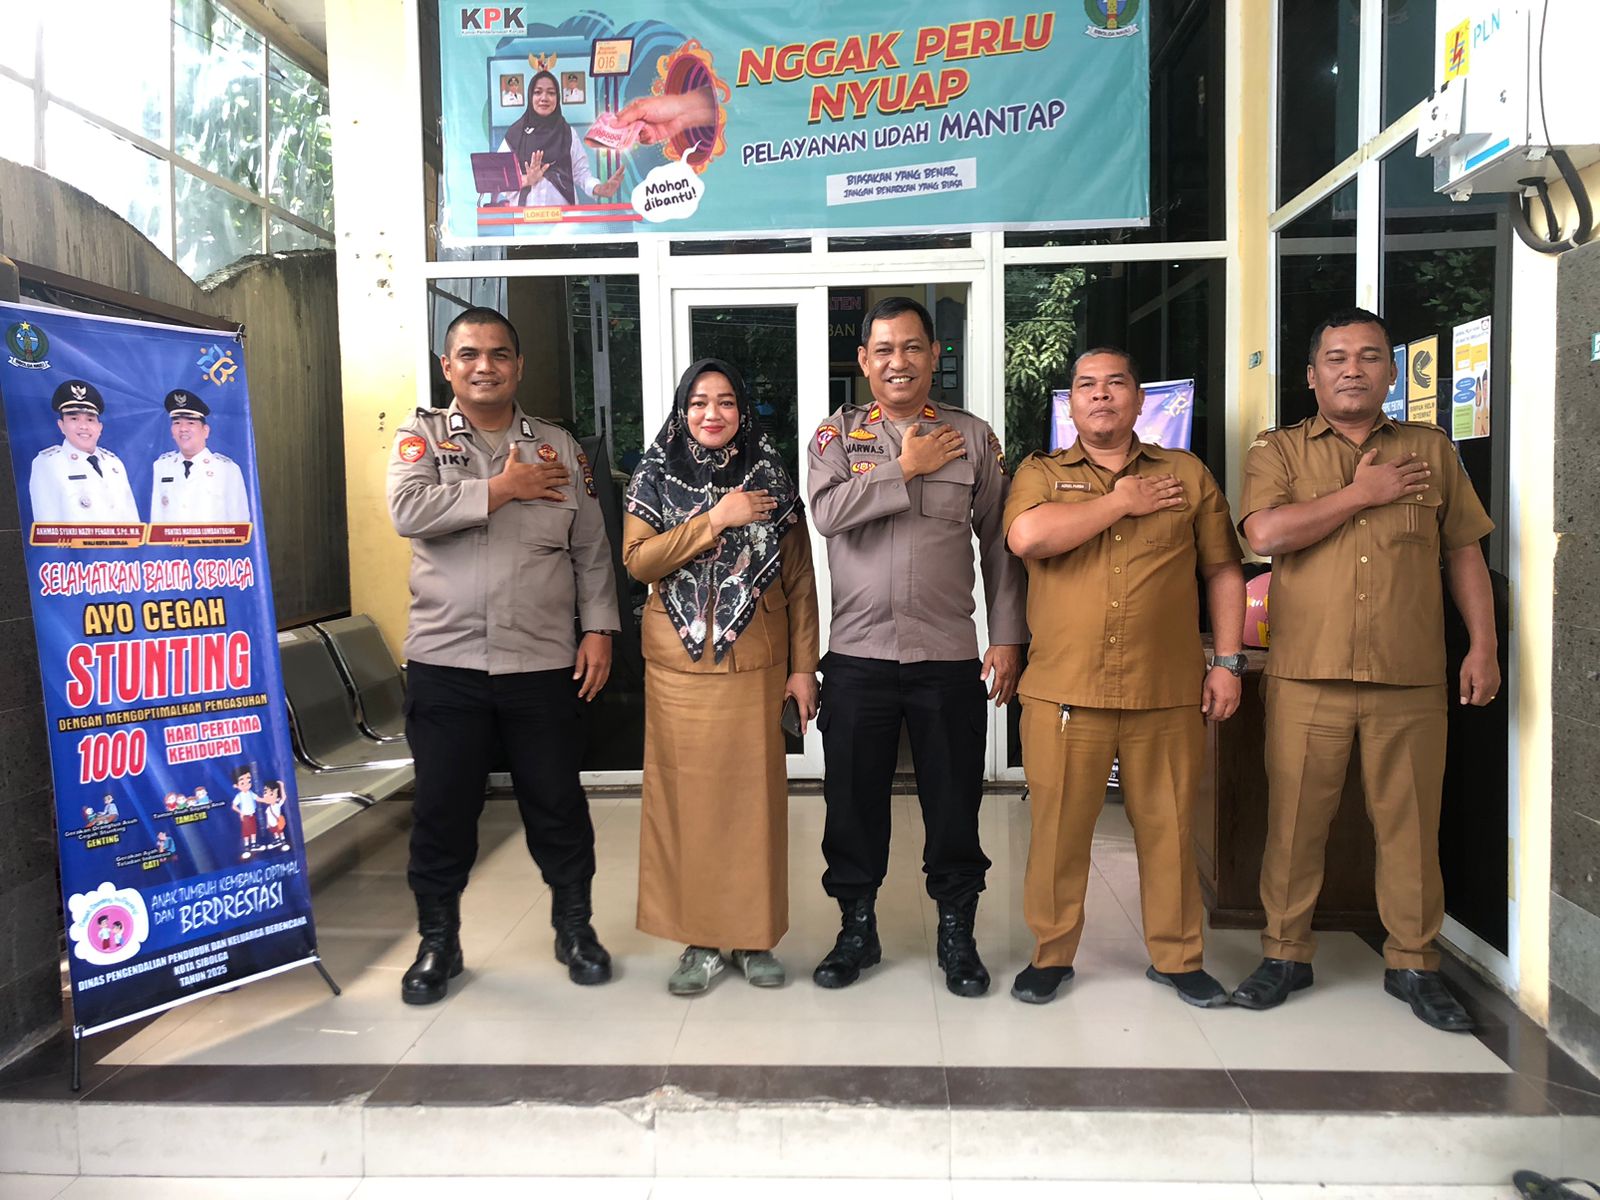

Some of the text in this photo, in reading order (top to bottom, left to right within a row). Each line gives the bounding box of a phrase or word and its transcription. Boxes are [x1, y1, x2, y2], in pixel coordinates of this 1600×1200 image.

[461, 7, 524, 29] KPK
[1473, 8, 1501, 49] PLN
[597, 56, 616, 69] 016
[736, 12, 1056, 87] NGGAK PERLU
[808, 67, 969, 124] NYUAP
[742, 100, 1066, 165] PELAYANAN UDAH MANTAP
[645, 178, 690, 197] Mohon
[843, 179, 963, 199] JANGAN BENARKAN YANG BIASA
[846, 171, 892, 186] BIASAKAN
[895, 168, 921, 181] YANG
[644, 187, 698, 212] dibantu!
[39, 557, 254, 596] SELAMATKAN BALITA SIBOLGA
[84, 597, 226, 635] AYO CEGAH
[66, 631, 251, 709] STUNTING
[57, 693, 268, 733] DENGAN MENGOPTIMALKAN PENGASUHAN
[164, 715, 262, 745] HARI PERTAMA
[78, 728, 147, 783] 1000
[167, 736, 242, 765] KEHIDUPAN
[86, 833, 120, 849] GENTING
[142, 860, 160, 871] GATI
[151, 859, 300, 911] ANAK TUMBUH KEMBANG OPTIMAL
[153, 908, 175, 926] DAN
[179, 881, 284, 934] BERPRESTASI
[78, 978, 105, 992] DINAS
[106, 957, 167, 984] PENGENDALIAN
[167, 944, 212, 969] PENDUDUK
[212, 940, 228, 953] DAN
[228, 928, 264, 949] KELUARGA
[173, 951, 229, 976] KOTA SIBOLGA
[180, 965, 228, 987] TAHUN 2025
